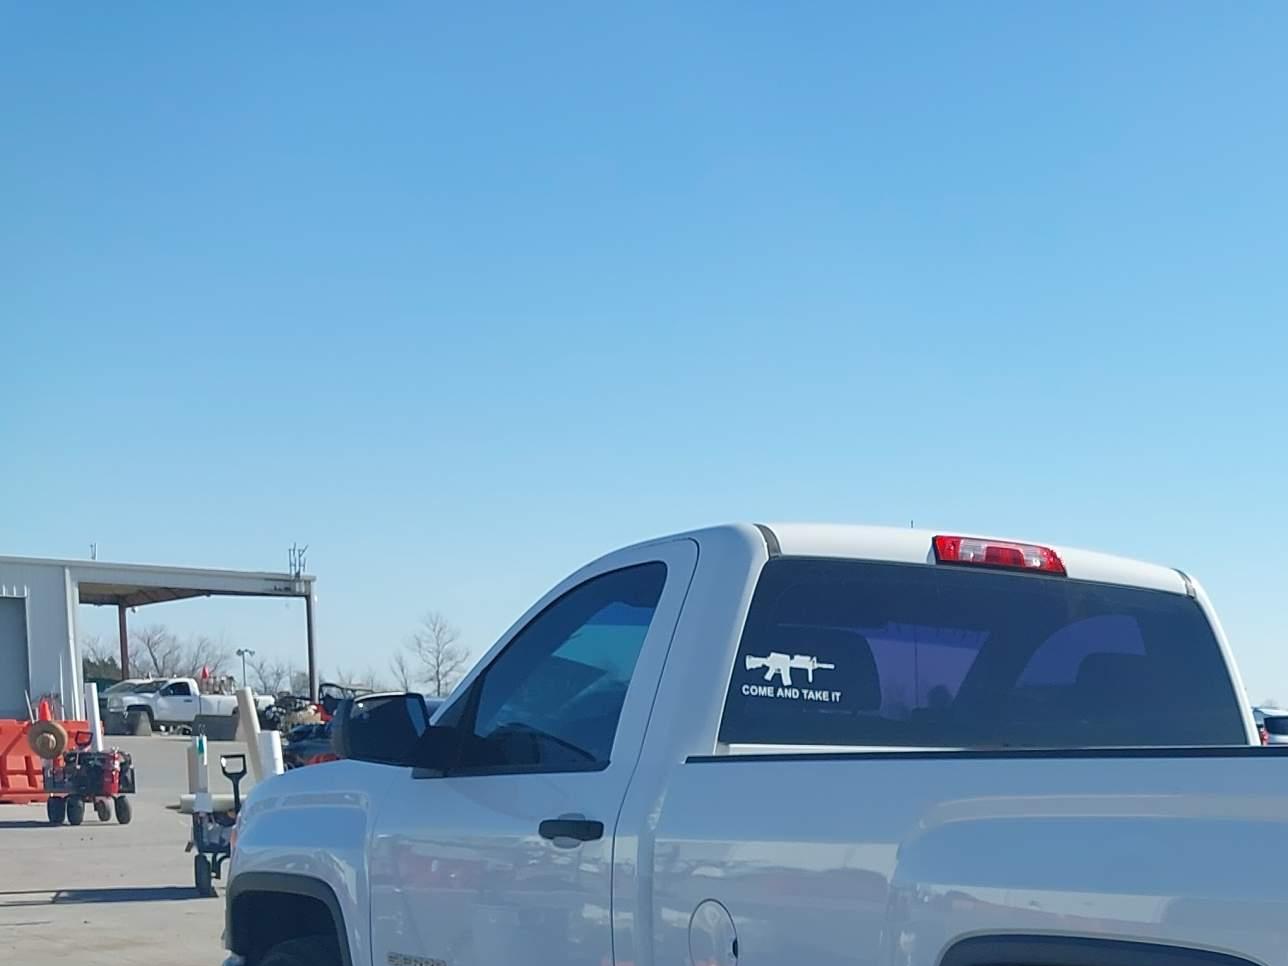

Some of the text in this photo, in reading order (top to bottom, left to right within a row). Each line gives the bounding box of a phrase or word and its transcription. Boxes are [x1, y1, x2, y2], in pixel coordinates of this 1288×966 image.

[742, 684, 842, 702] COME AND TAKE IT
